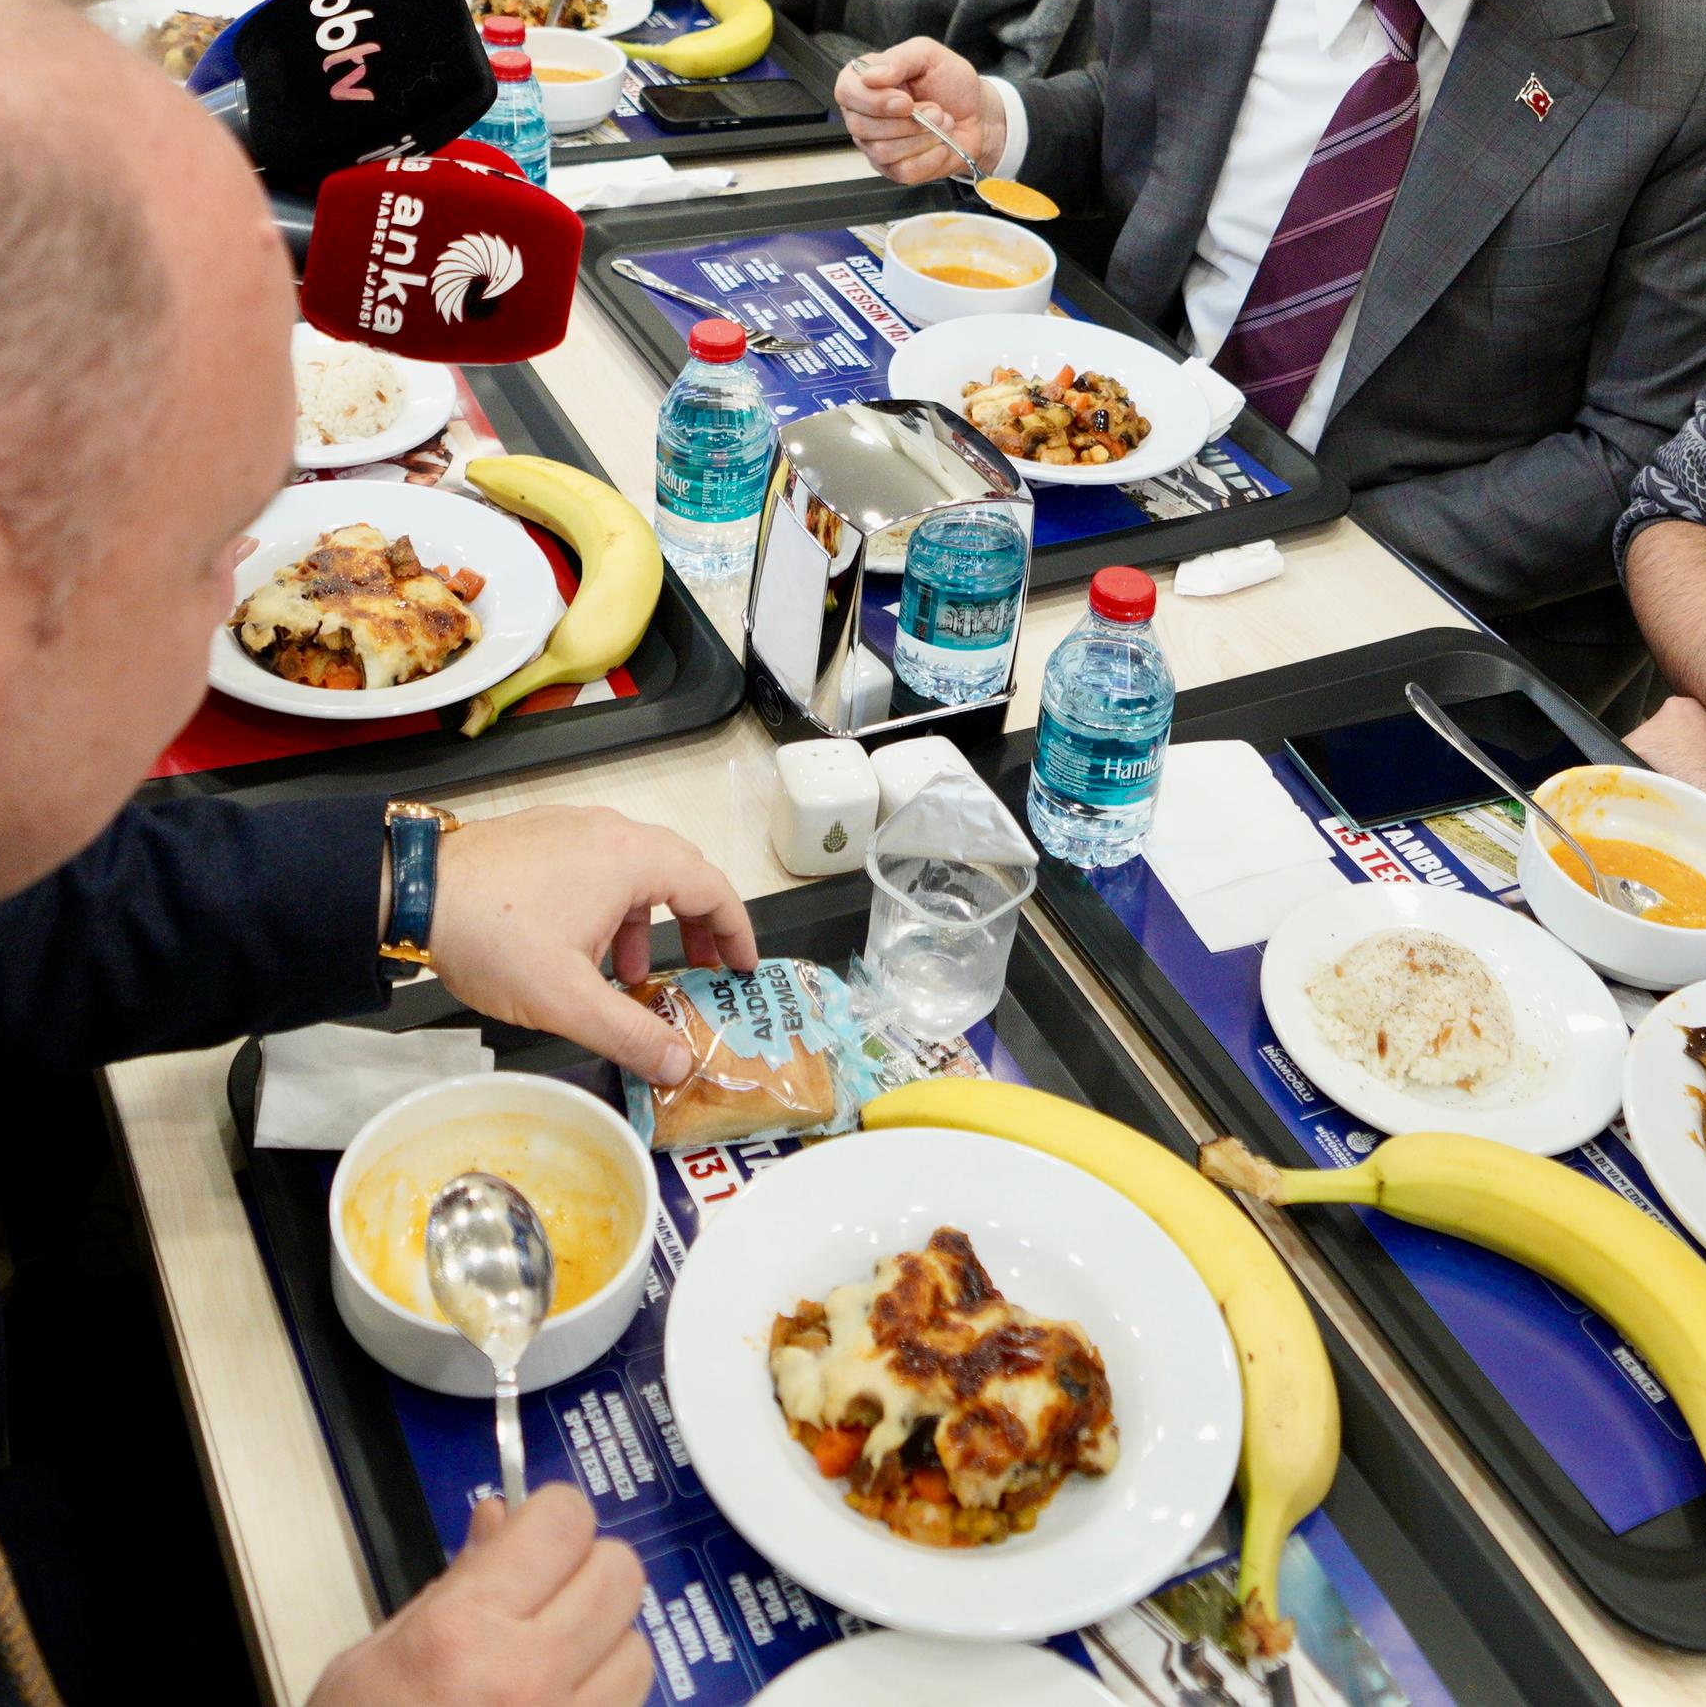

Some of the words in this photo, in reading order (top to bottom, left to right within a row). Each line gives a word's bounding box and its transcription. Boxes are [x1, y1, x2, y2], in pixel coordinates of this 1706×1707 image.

[370, 191, 395, 257] HABER
[358, 261, 381, 330] AJANSI
[371, 194, 428, 335] anka
[709, 978, 744, 1026] SADE
[763, 963, 804, 1033] EKMEĞİ
[1262, 1044, 1315, 1103] İMAMOĞLU
[681, 1146, 728, 1181] 13
[1594, 1157, 1628, 1188] DEVAM
[1624, 1187, 1652, 1214] EDEN
[1612, 1345, 1668, 1404] MERKEZİ
[562, 1408, 592, 1451] SPOR
[577, 1446, 612, 1497] TESİSİ
[579, 1388, 613, 1443] YAŞAM
[597, 1437, 639, 1502] MERKEZİ
[602, 1392, 656, 1484] ARNAVUTKÖY
[640, 1380, 674, 1427] ŞEHİR
[660, 1423, 691, 1469] STADI
[665, 1596, 708, 1665] FLORYA
[684, 1579, 734, 1664] BAKIRKÖY
[728, 1570, 776, 1648] MERKEZİ
[755, 1576, 789, 1625] SPOR
[650, 1622, 697, 1702] MERKEZİ
